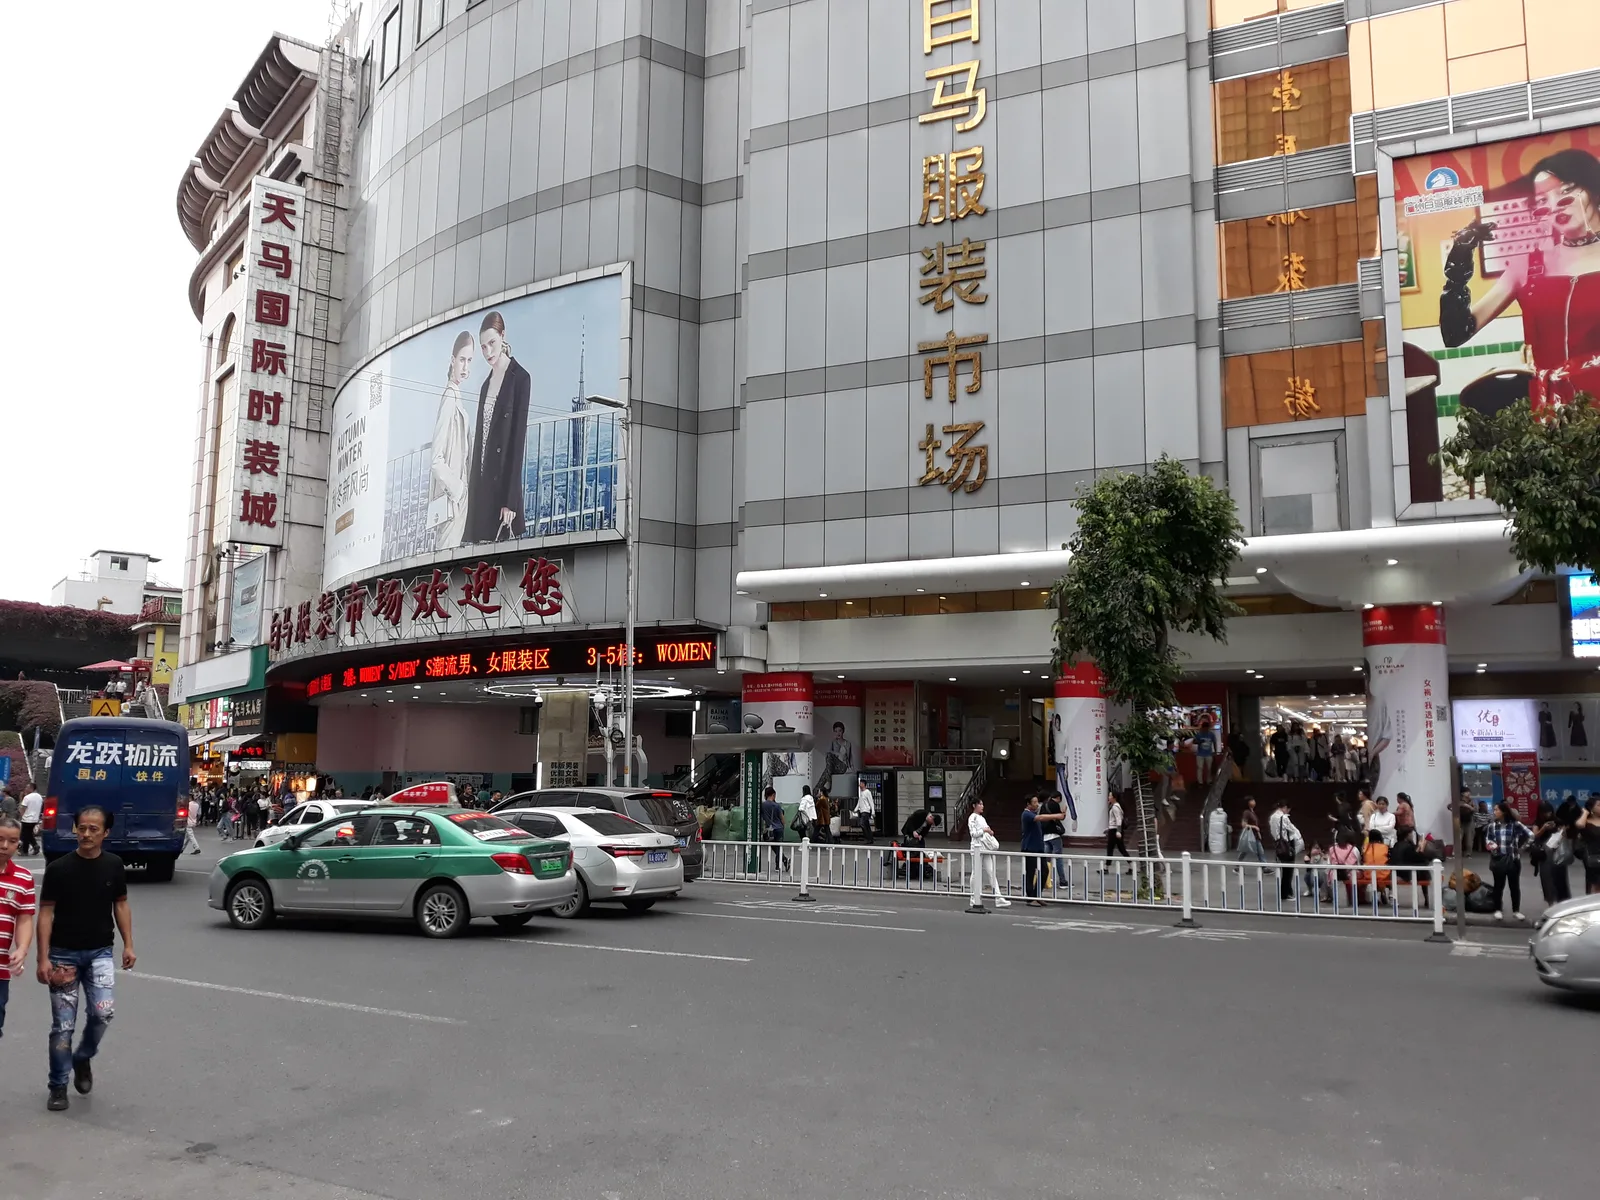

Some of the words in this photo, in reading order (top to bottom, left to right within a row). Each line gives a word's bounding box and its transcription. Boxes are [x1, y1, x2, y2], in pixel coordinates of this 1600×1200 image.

[239, 192, 297, 529] 天马国际时装城
[337, 415, 367, 455] AUTUMN
[337, 440, 363, 475] WINTER
[331, 463, 370, 514] 秋冬新风尚
[268, 556, 563, 651] 白马服装市场欢迎您
[656, 642, 712, 662] WOMEN
[66, 741, 178, 767] 龙跃物流
[77, 768, 107, 781] 国内
[136, 770, 164, 782] 快件
